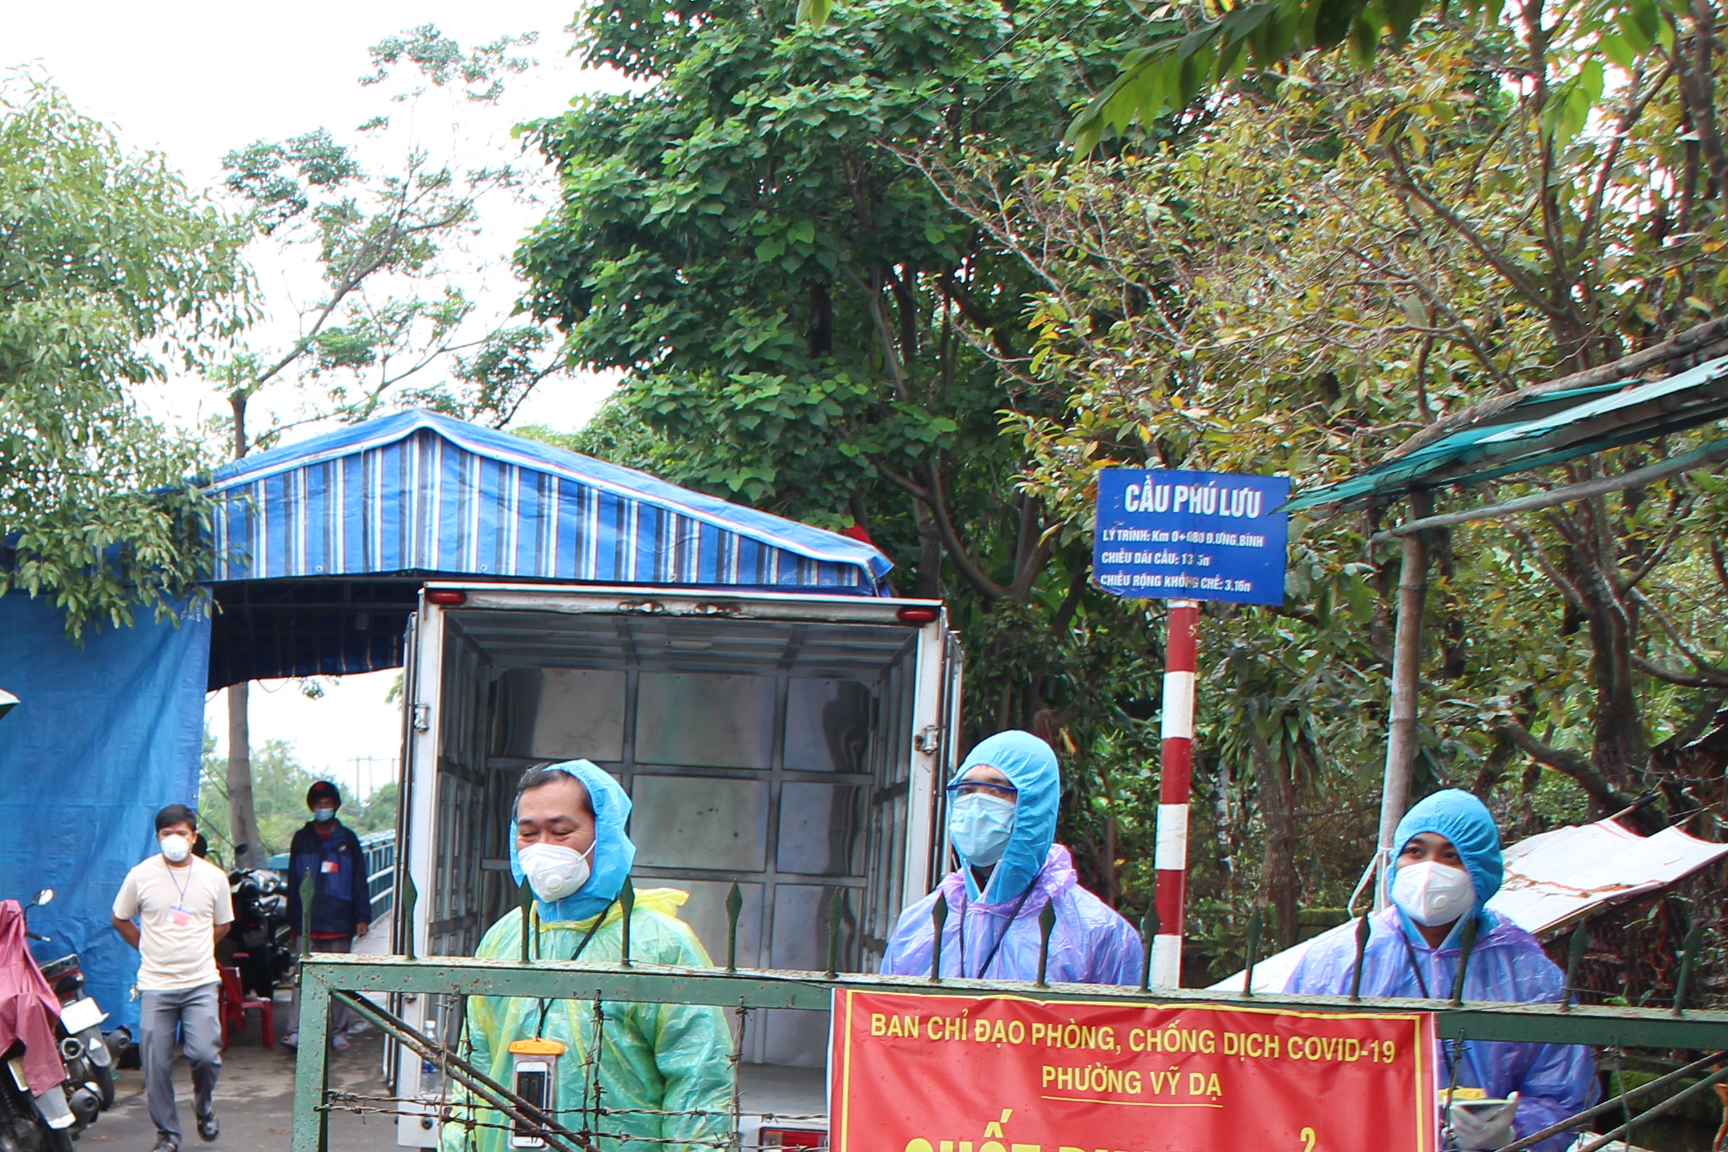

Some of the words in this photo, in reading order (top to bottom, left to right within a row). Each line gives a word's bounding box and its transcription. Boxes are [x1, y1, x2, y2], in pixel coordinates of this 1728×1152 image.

[1124, 474, 1170, 513] CẦU
[1173, 480, 1218, 516] PHÚ
[1219, 487, 1262, 519] LƯU
[1102, 527, 1116, 541] LÝ
[1152, 530, 1169, 542] Km
[1101, 547, 1132, 564] CHIỀU
[1153, 548, 1180, 565] CẦU:
[1100, 569, 1131, 586] CHIỀU
[1132, 572, 1162, 589] RỘNG
[870, 1013, 920, 1039] BAN
[926, 1008, 969, 1042] CHỈ
[974, 1019, 1026, 1048] ĐẠO
[1031, 1018, 1121, 1055] PHÒNG,
[1129, 1019, 1216, 1057] CHỐNG
[1222, 1033, 1281, 1064] DỊCH
[1287, 1036, 1396, 1064] COVID-19
[1041, 1063, 1142, 1095] PHƯỜNG
[1150, 1065, 1181, 1096] VỸ
[1188, 1071, 1223, 1099] DẠ
